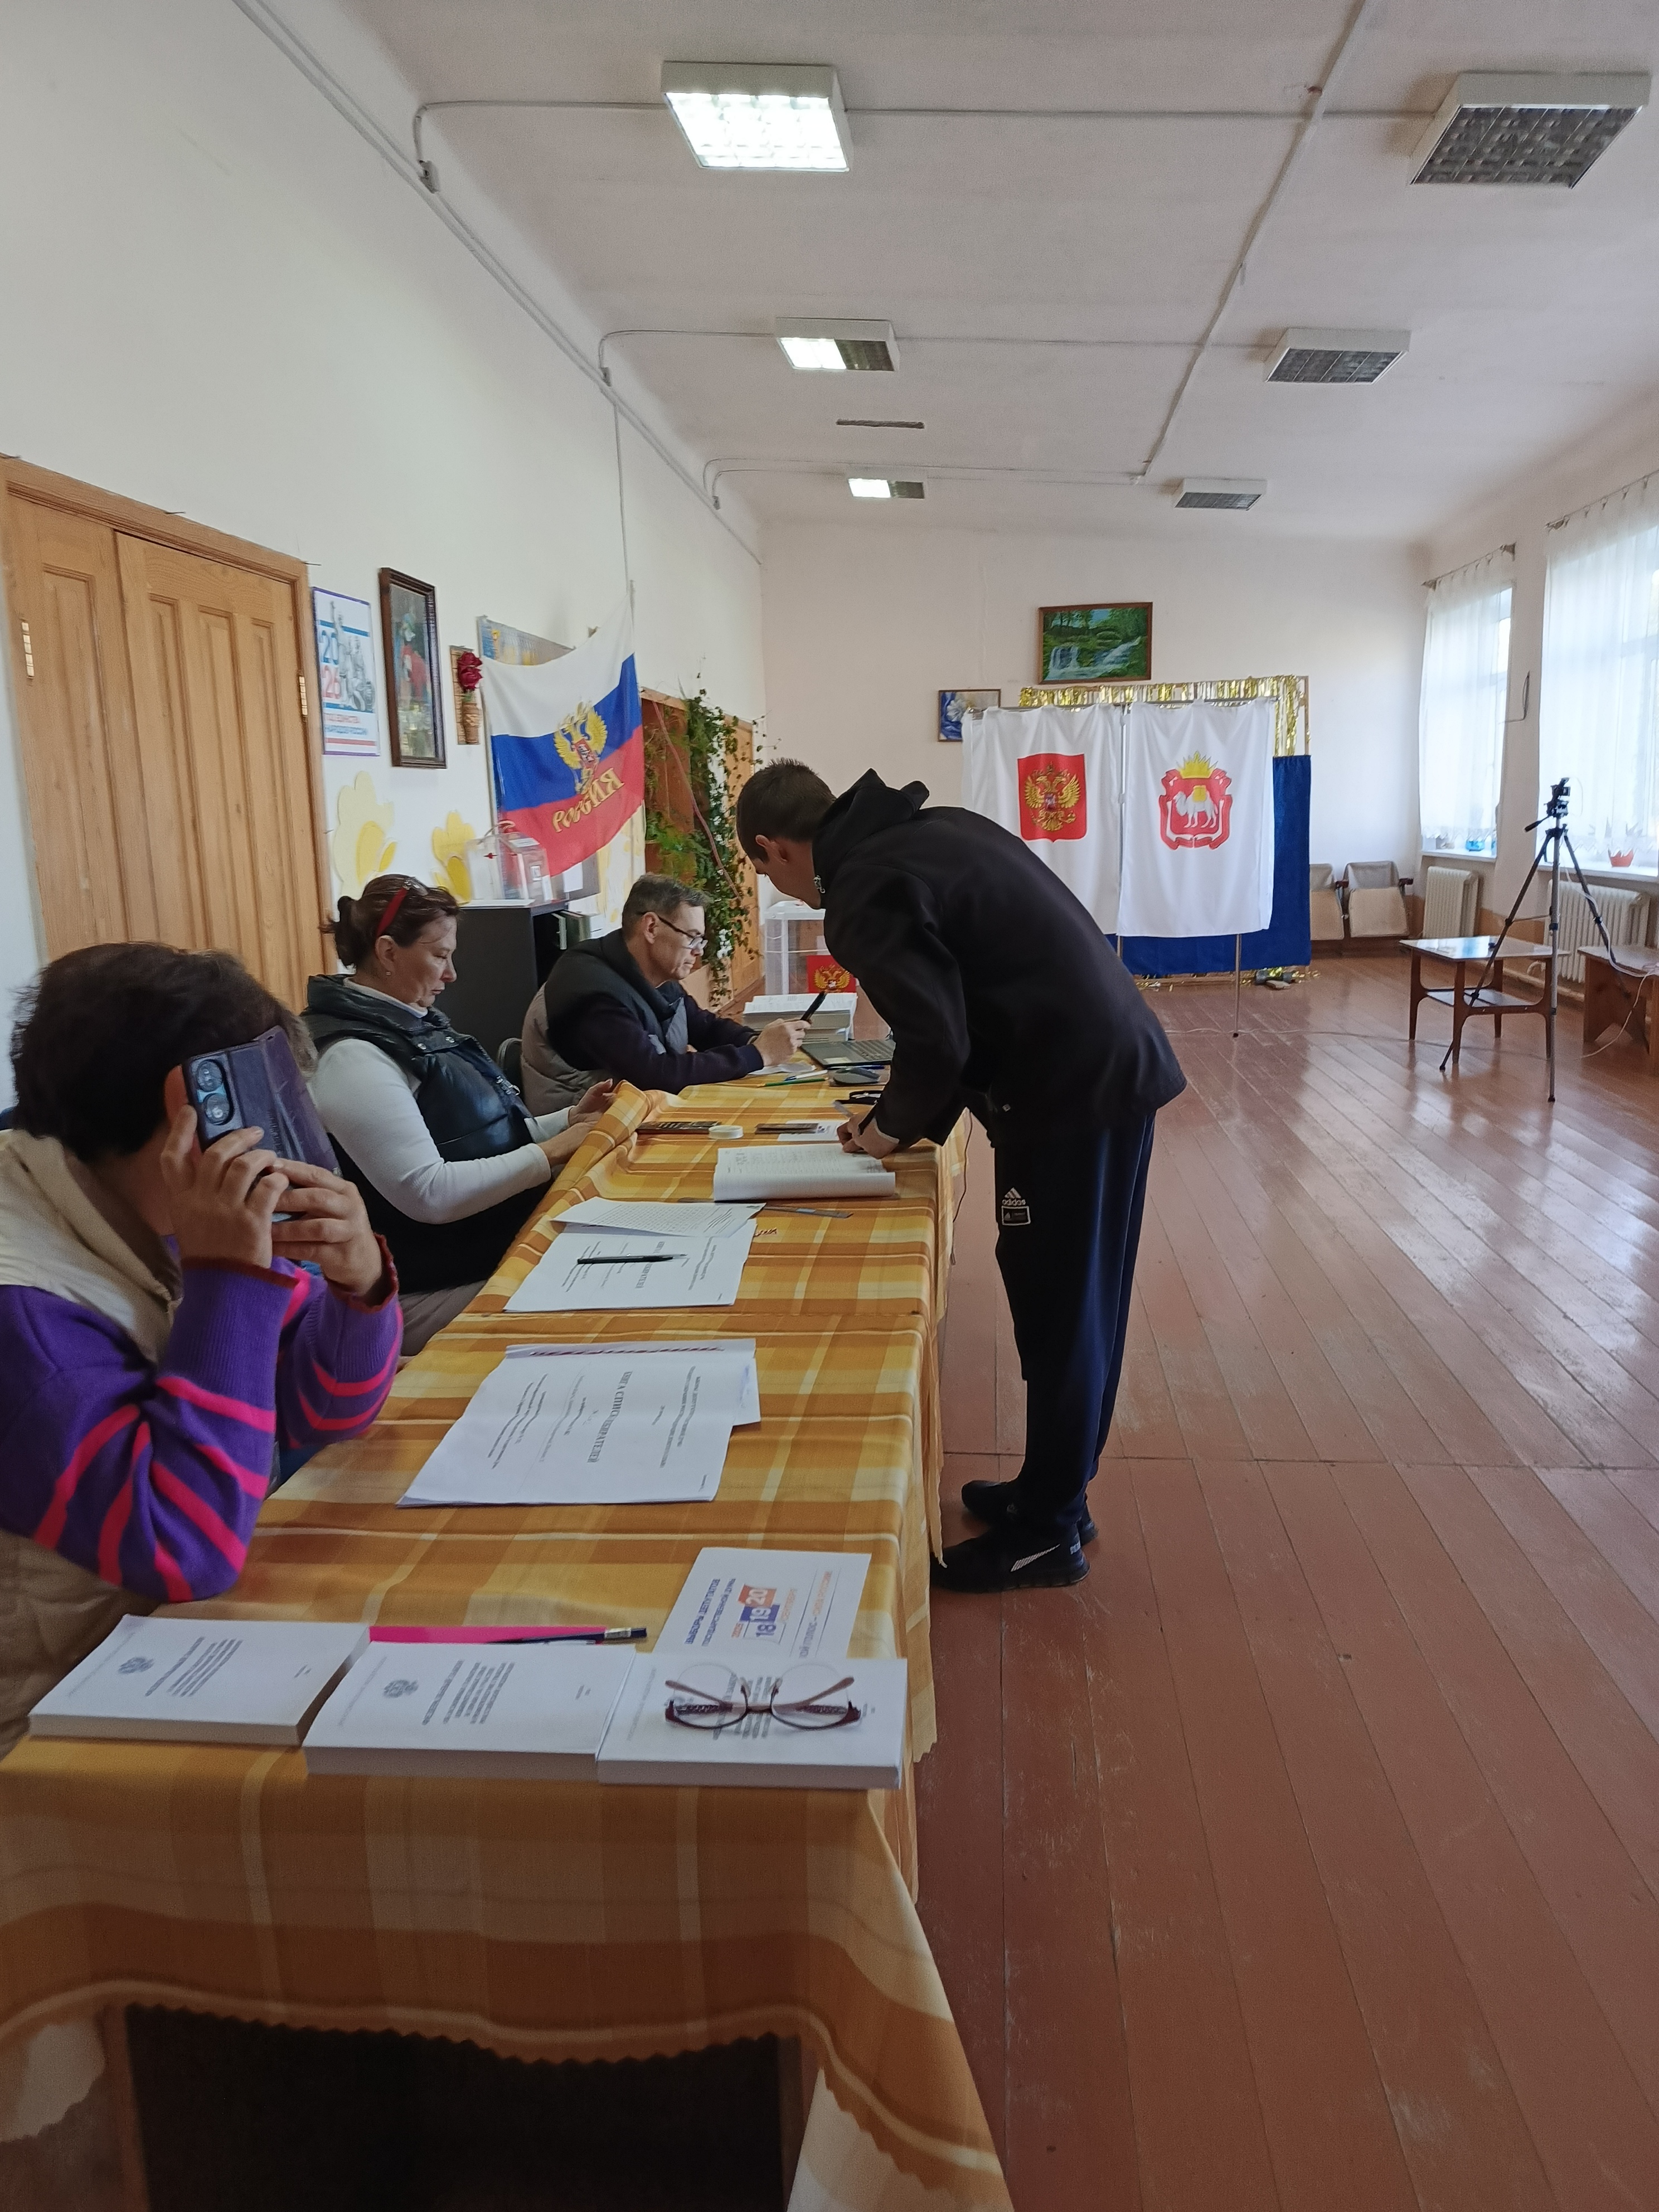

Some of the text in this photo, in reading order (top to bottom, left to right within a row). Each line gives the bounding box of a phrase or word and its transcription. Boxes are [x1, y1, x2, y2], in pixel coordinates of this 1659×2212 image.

[745, 1589, 768, 1605] 20
[750, 1607, 772, 1623] 19
[756, 1623, 777, 1637] 18
